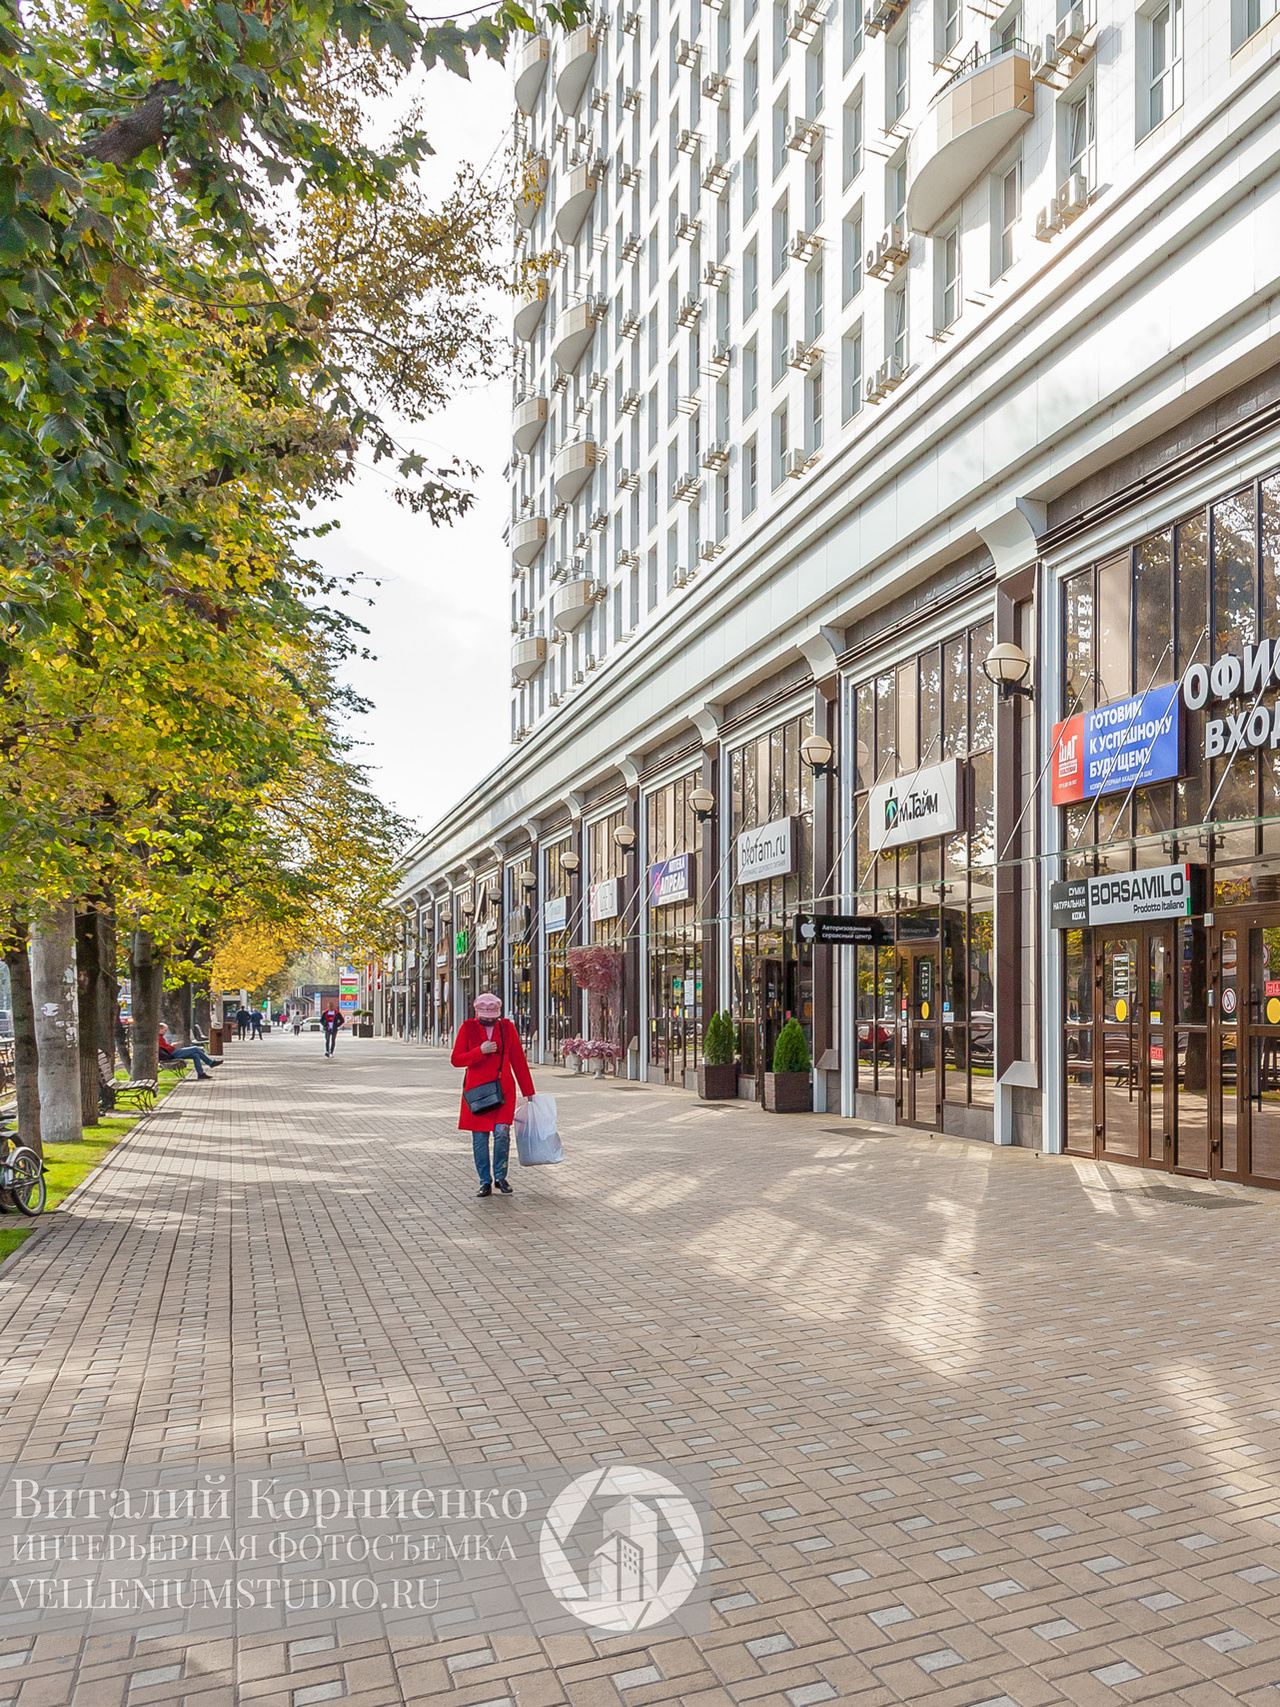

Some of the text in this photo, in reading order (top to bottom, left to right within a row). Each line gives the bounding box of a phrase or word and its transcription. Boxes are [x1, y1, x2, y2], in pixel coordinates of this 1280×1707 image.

[1089, 699, 1143, 731] ГОТОВИМ
[1058, 735, 1078, 763] ШАГ
[1089, 715, 1173, 755] К УСПЕШНОМУ
[1089, 747, 1152, 779] БУДУЩЕМУ
[898, 789, 938, 822] м.Тайм
[1068, 886, 1086, 897] СУМКИ
[1091, 872, 1184, 906] BORSAMILO
[1053, 899, 1086, 911] НАТУРАЛЬНАЯ
[1133, 900, 1185, 914] Prodotto Italiano
[821, 924, 872, 932] Авторизованный
[821, 932, 854, 940] сервисный
